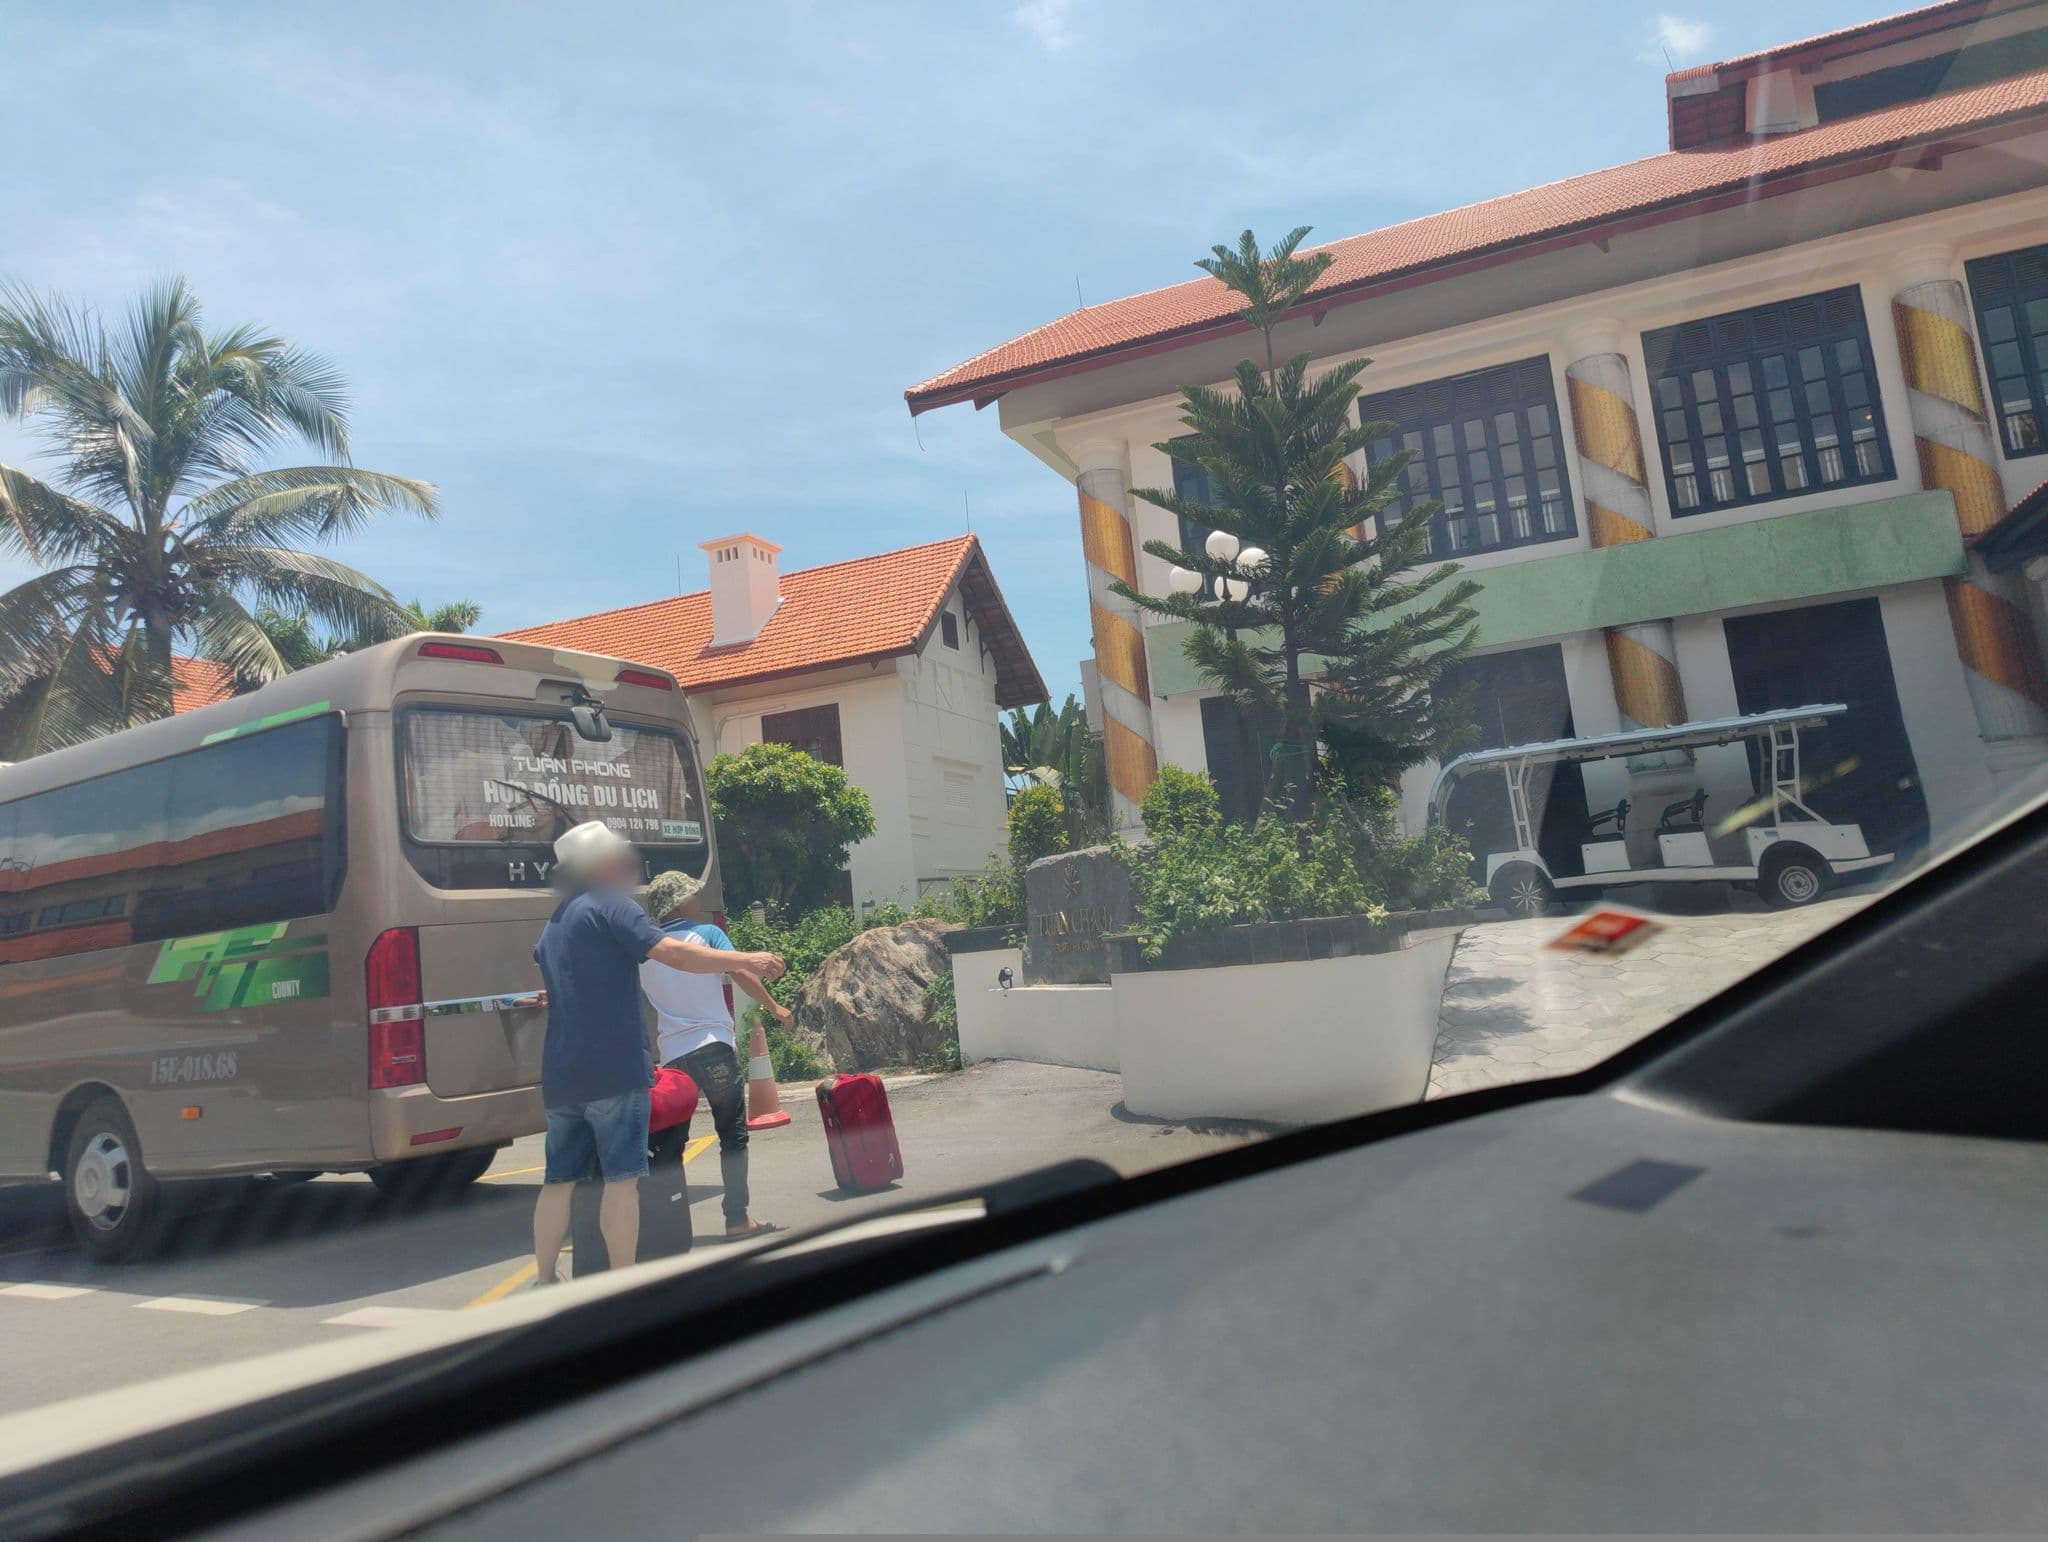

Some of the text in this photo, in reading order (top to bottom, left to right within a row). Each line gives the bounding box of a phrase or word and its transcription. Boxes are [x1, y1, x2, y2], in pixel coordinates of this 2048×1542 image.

[572, 760, 632, 778] PHONG
[593, 785, 618, 807] DU
[621, 787, 659, 812] LỊCH
[271, 980, 300, 999] COUNTY
